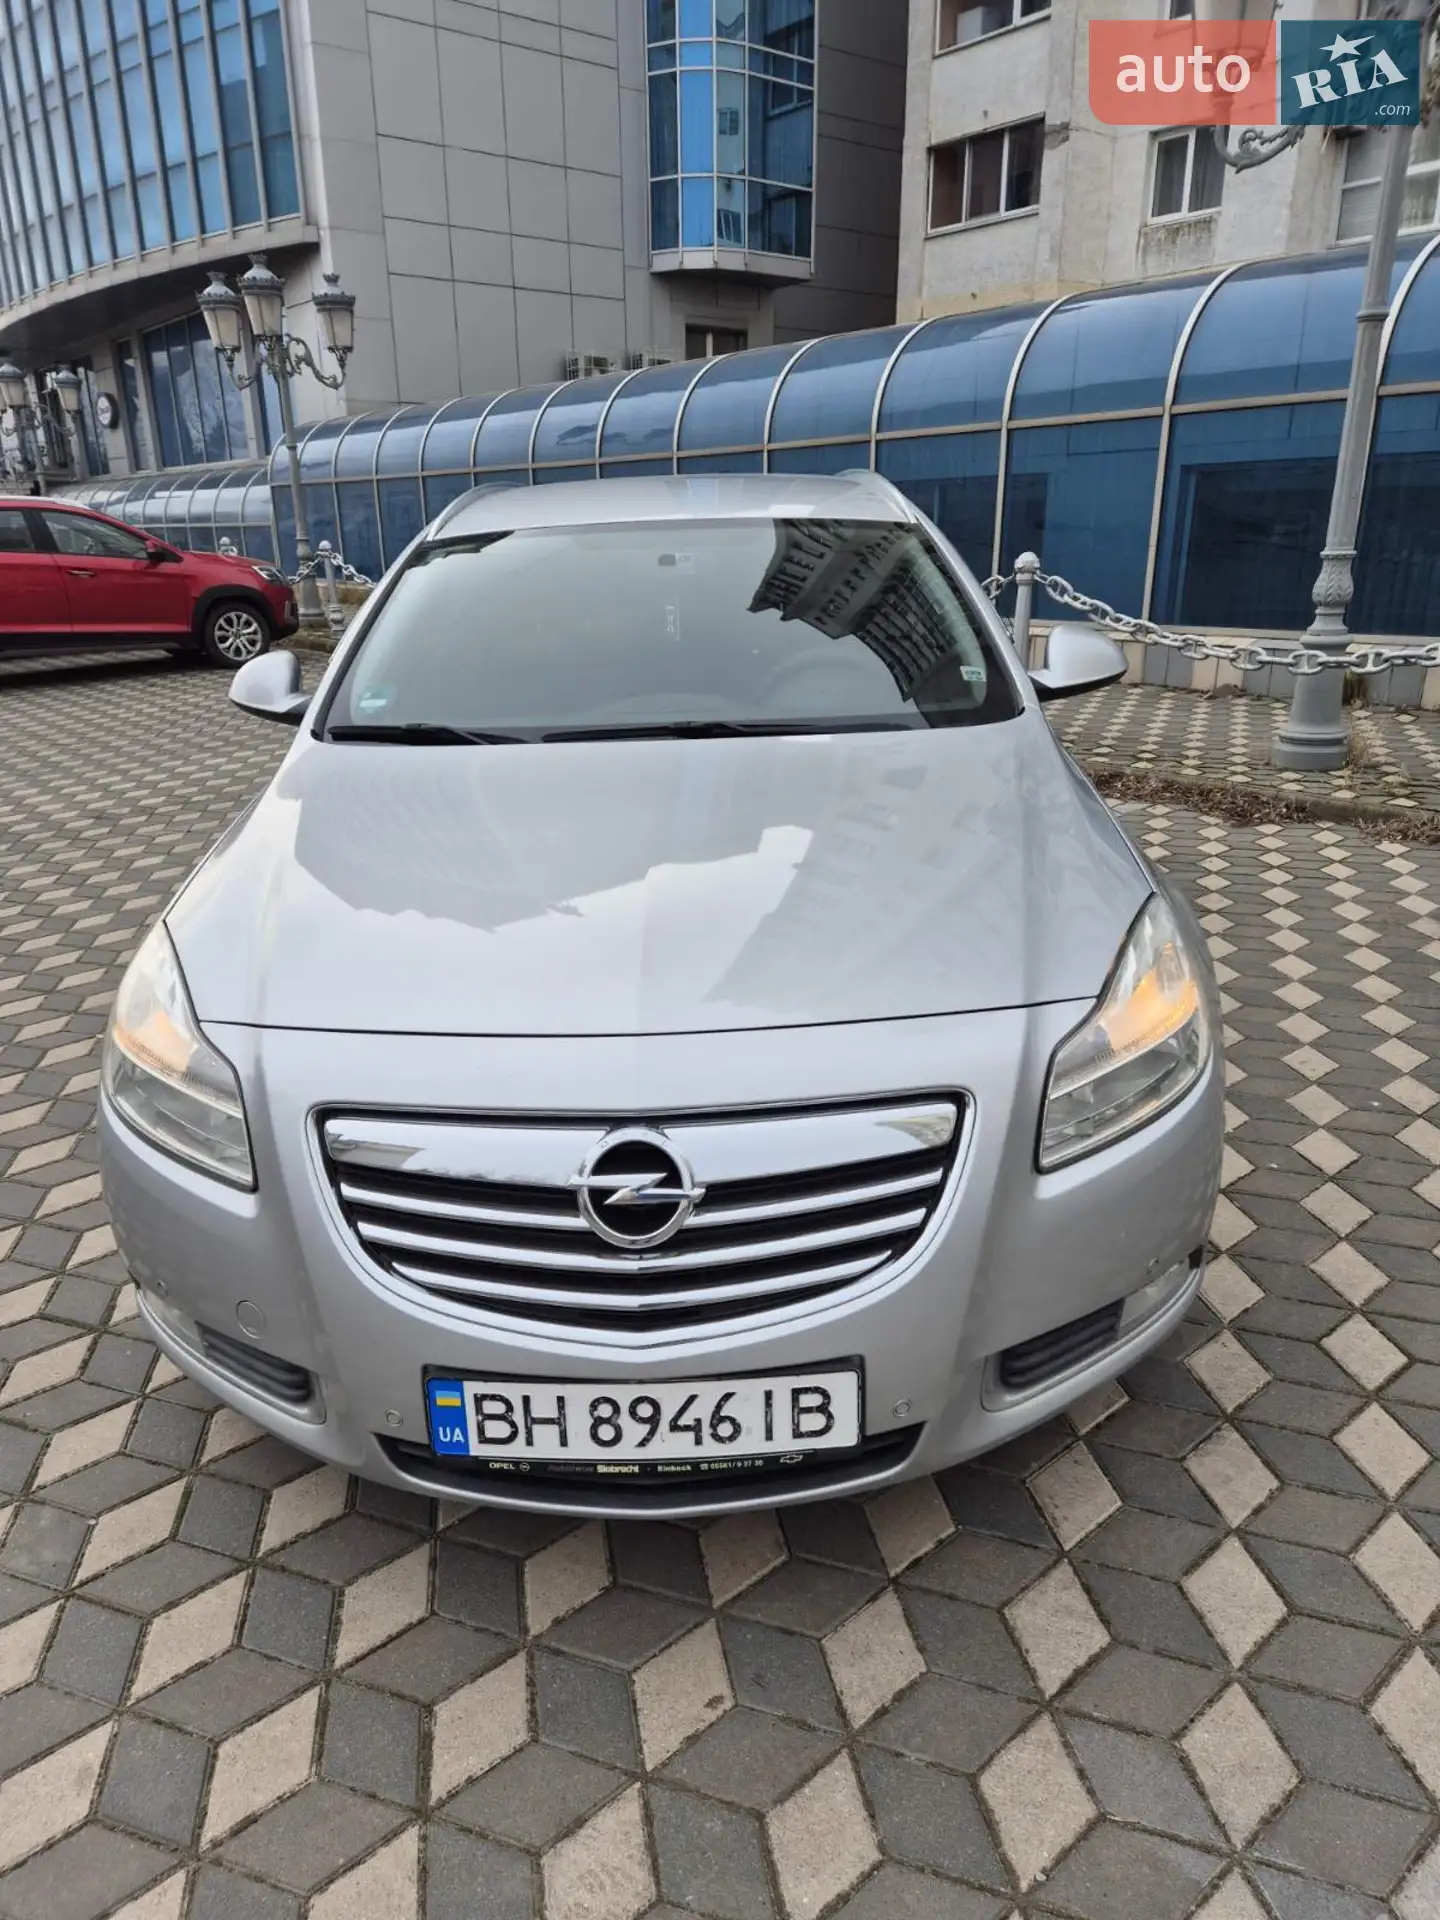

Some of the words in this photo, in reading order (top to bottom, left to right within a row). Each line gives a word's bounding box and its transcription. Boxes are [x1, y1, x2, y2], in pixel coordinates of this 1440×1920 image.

[473, 1392, 568, 1448] BH
[589, 1389, 741, 1448] 8946
[764, 1385, 835, 1442] IB
[438, 1426, 465, 1443] UA
[489, 1462, 515, 1470] OPEL
